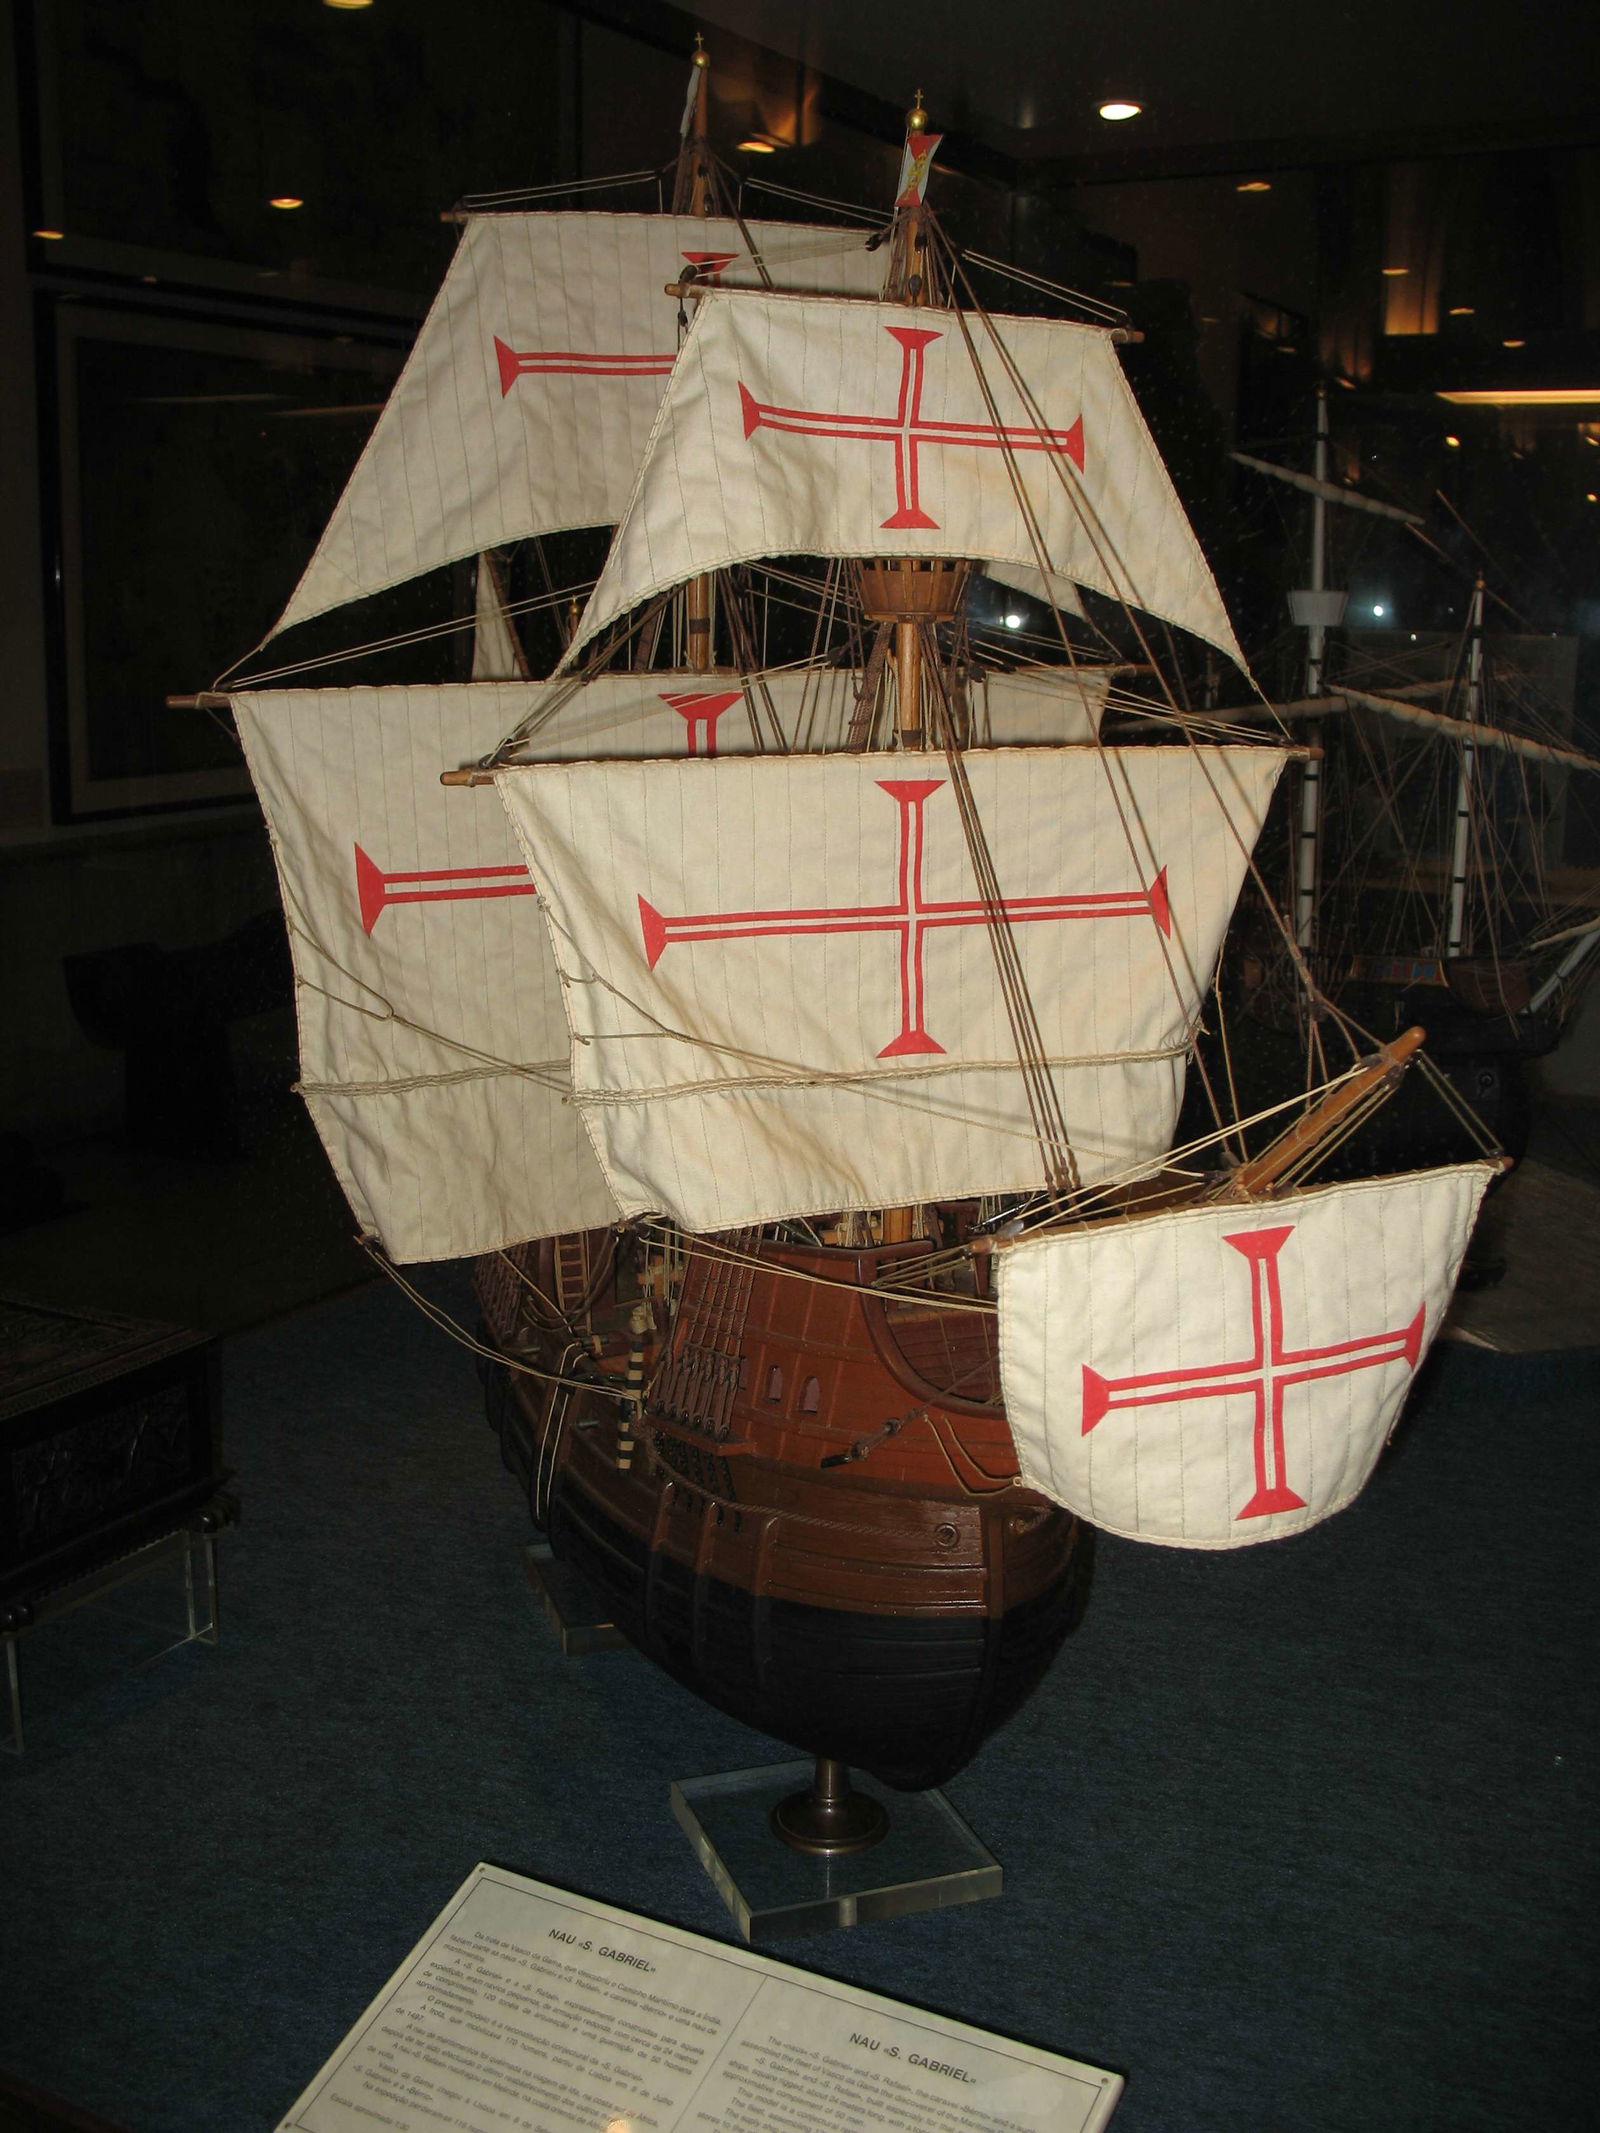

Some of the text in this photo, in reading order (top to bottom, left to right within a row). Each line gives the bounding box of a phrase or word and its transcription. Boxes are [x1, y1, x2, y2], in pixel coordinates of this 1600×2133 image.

[547, 1929, 576, 1944] NAU
[576, 1939, 597, 1952] «S.
[848, 2032, 881, 2051] NAU
[881, 2044, 905, 2059] «S.
